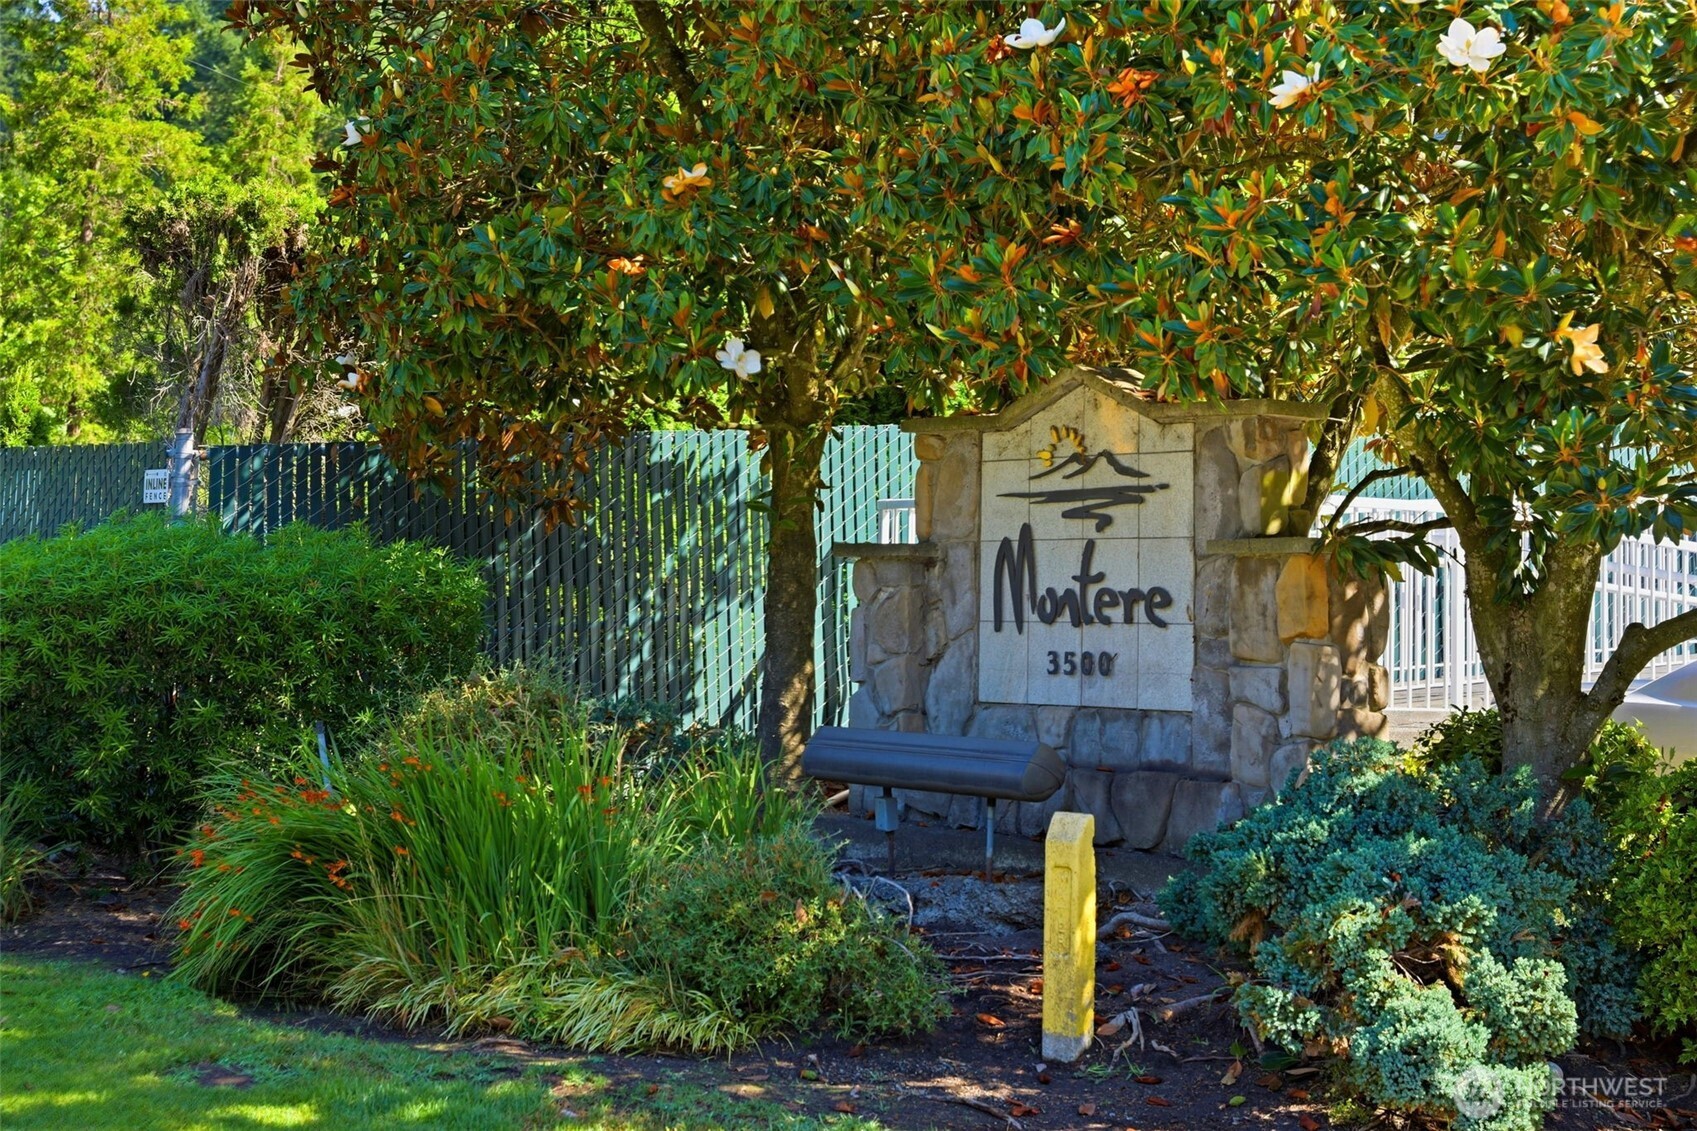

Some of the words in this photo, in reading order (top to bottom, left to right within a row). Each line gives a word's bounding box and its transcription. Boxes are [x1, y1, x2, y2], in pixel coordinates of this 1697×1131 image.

[145, 477, 167, 490] INLINE
[145, 491, 167, 501] FENCE
[993, 522, 1173, 635] Montere
[1047, 651, 1113, 676] 3500
